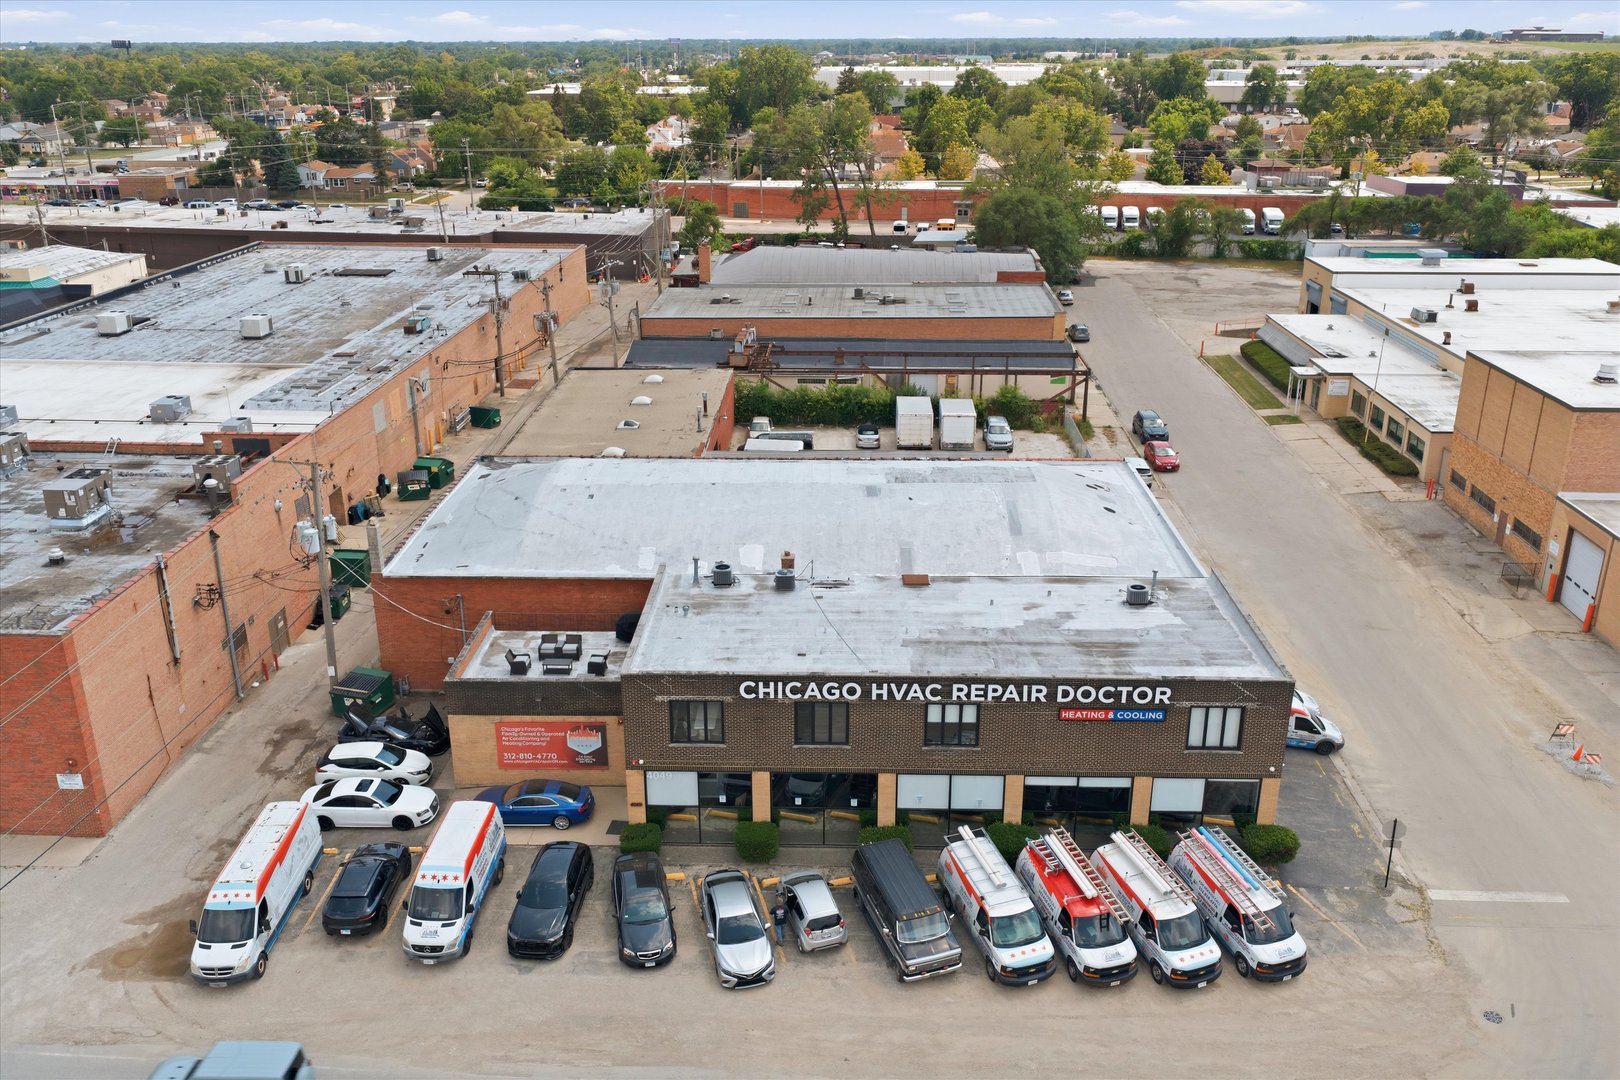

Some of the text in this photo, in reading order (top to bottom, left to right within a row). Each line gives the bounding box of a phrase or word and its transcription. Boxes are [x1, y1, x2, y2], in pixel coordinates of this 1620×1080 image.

[739, 681, 1172, 705] CHICAGO HVAC REPAIR DOCTOR
[1061, 710, 1163, 720] HEATING & COOLING
[646, 771, 673, 780] 4049
